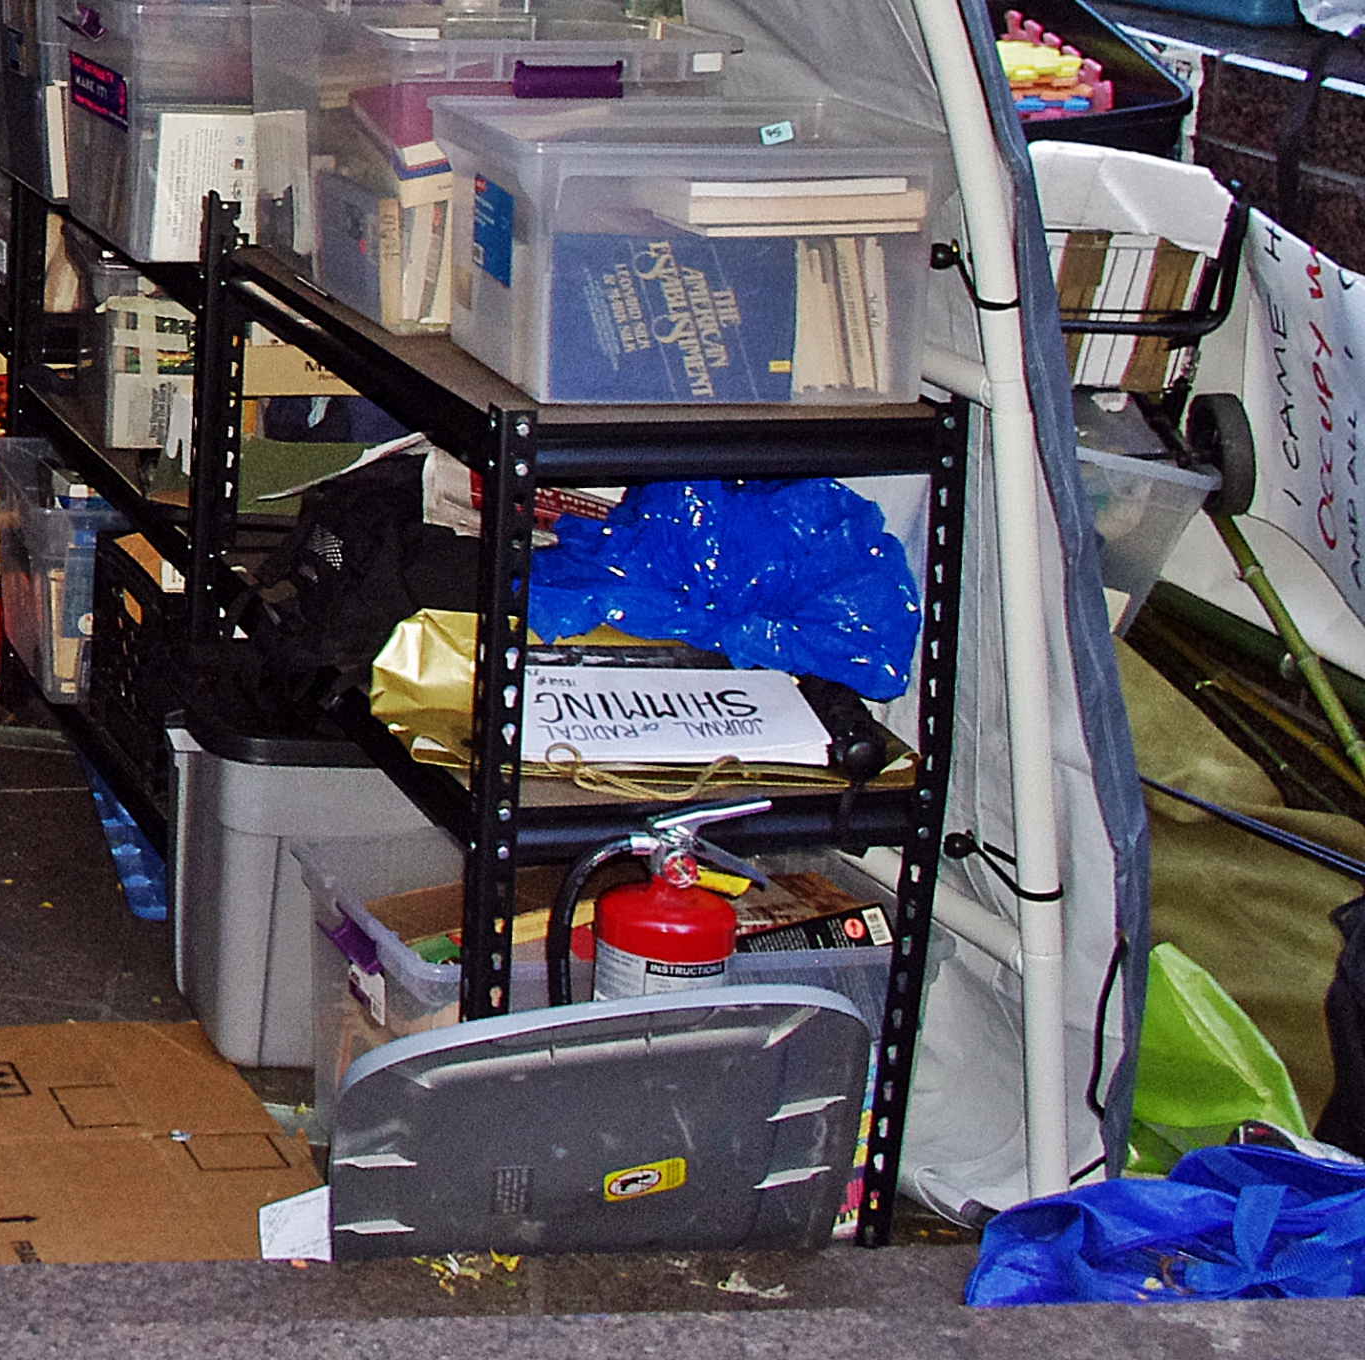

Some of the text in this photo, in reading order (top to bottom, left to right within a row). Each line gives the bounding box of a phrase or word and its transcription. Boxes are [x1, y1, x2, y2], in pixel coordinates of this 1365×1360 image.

[633, 241, 715, 397] ESTABLISHMENT
[680, 265, 729, 367] AMERICAN
[711, 287, 742, 327] THE
[1266, 292, 1300, 471] CAME
[1308, 320, 1337, 551] OCCUPY
[1347, 409, 1358, 486] ALL
[1284, 488, 1302, 507] I
[1347, 497, 1362, 590] AND
[533, 689, 759, 723] SHIMMING
[538, 721, 640, 741] RADICAL
[674, 717, 764, 739] JOURNAL
